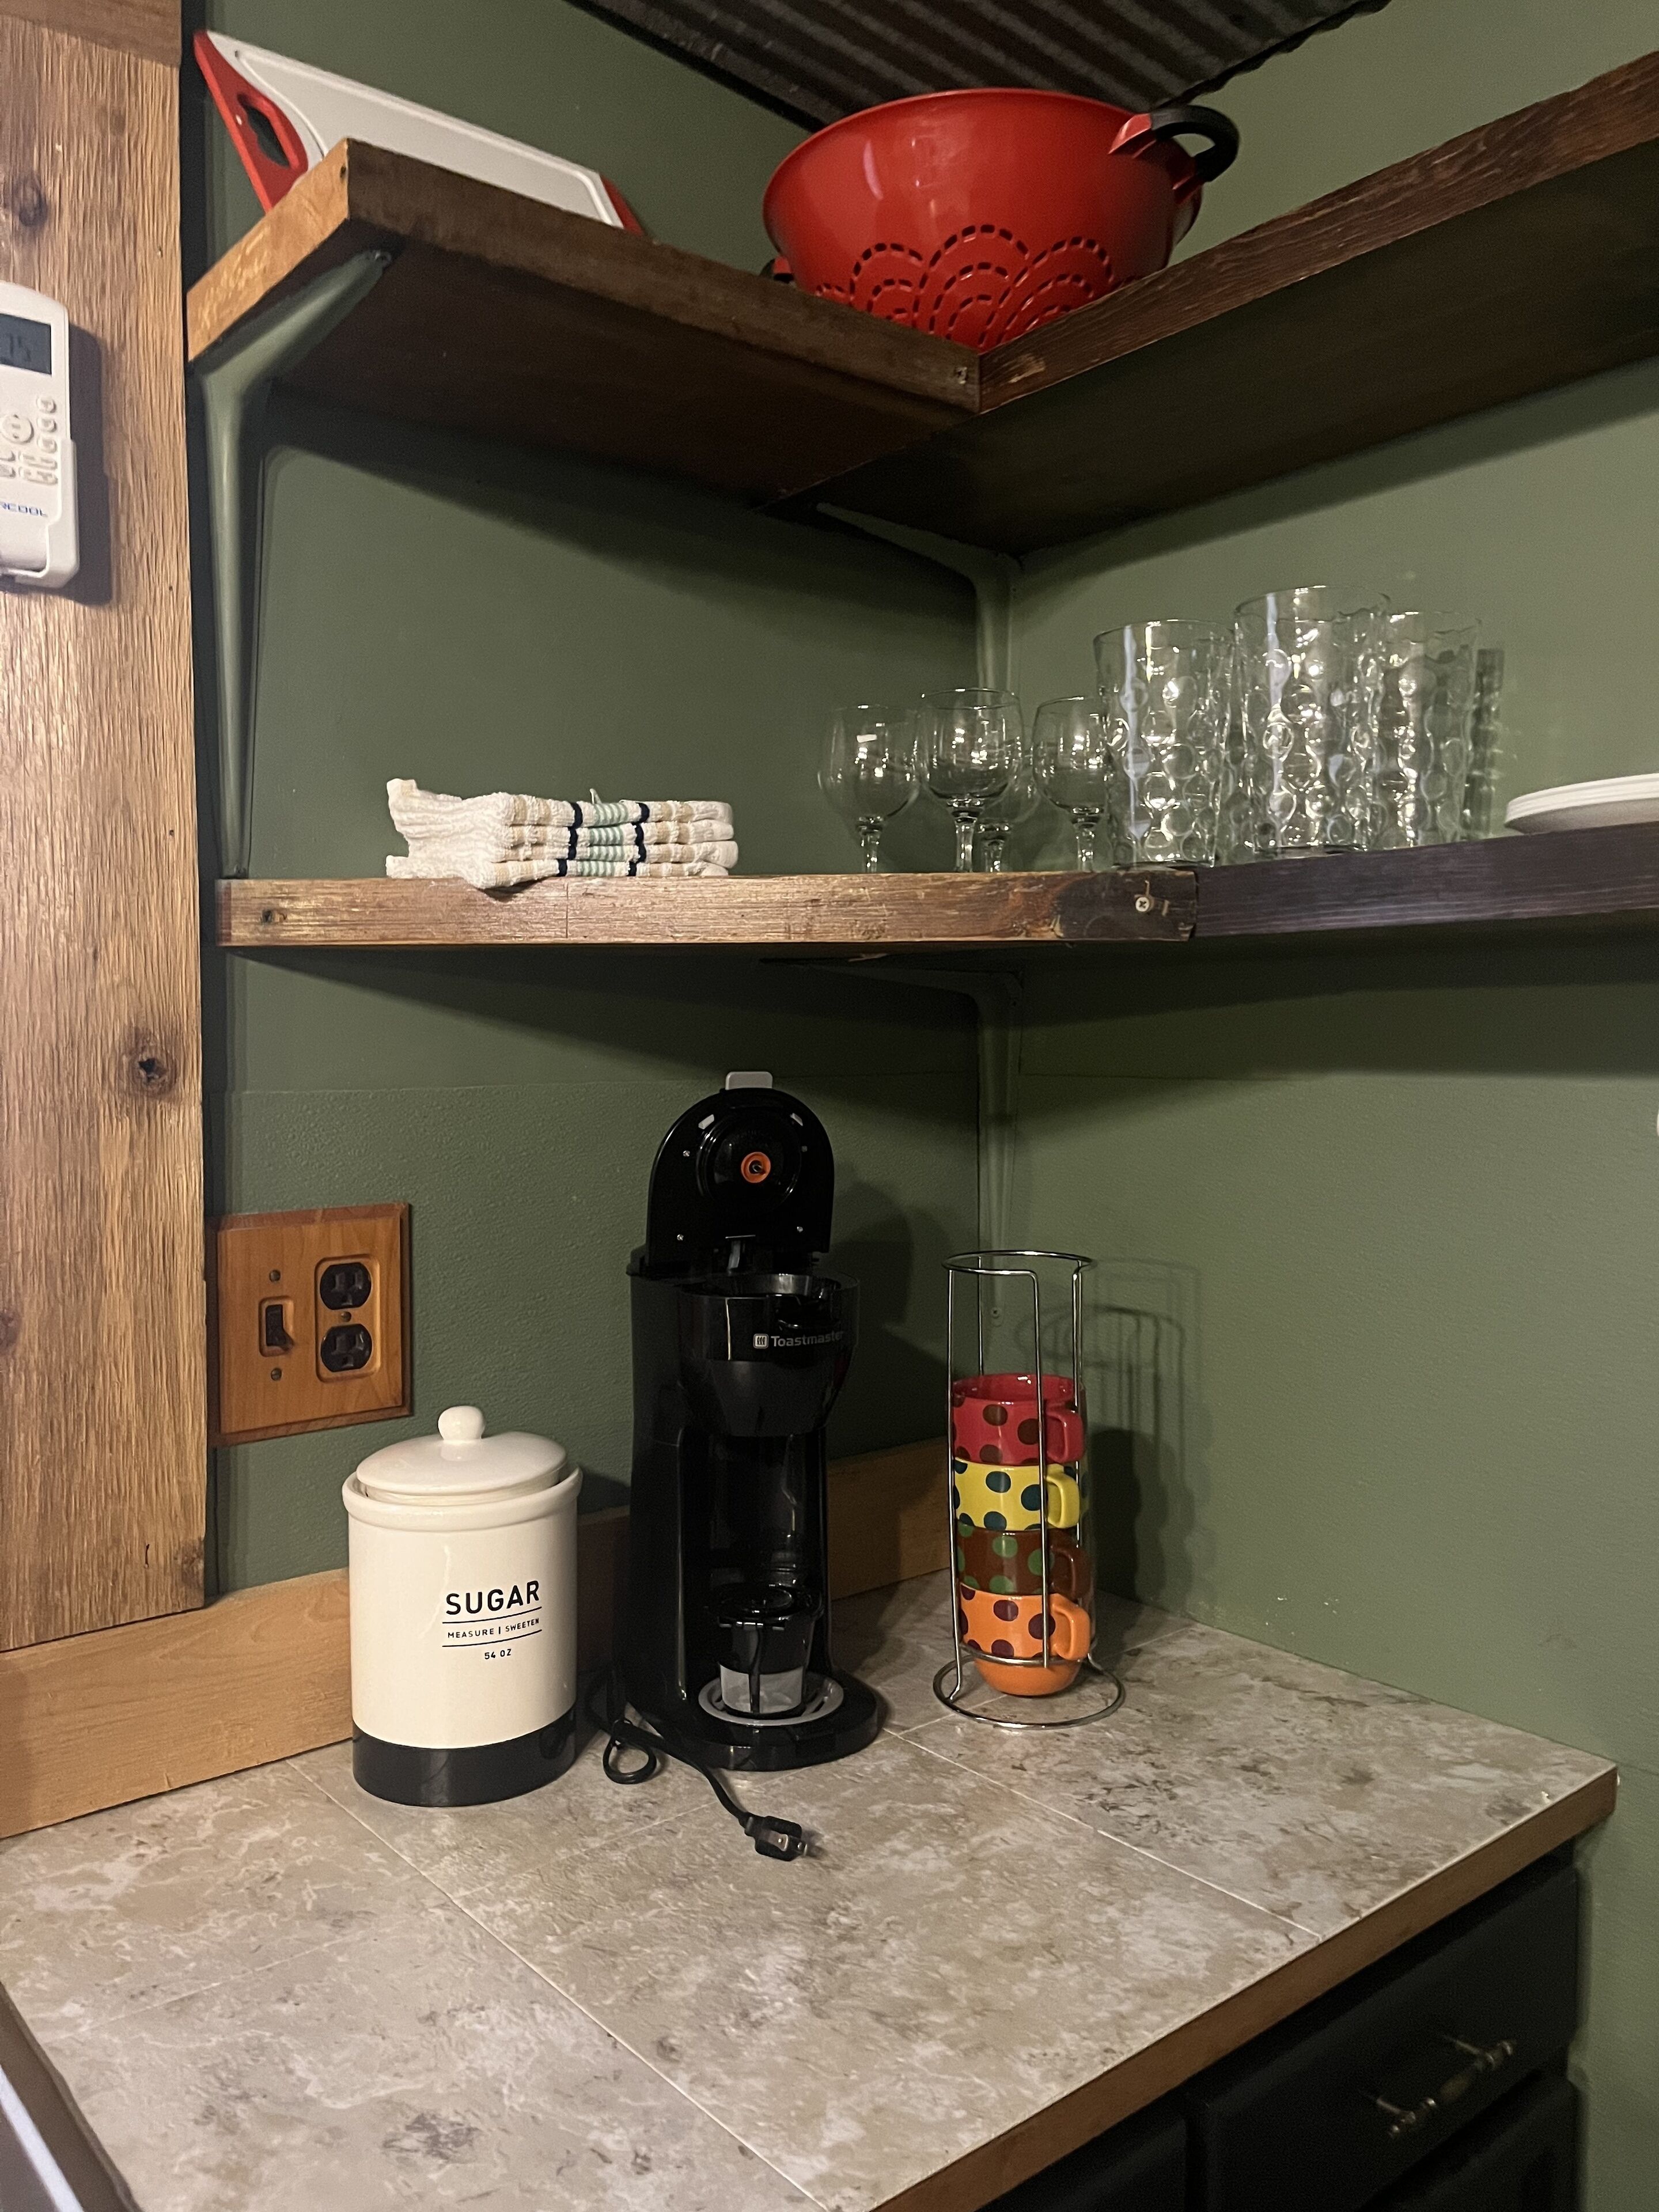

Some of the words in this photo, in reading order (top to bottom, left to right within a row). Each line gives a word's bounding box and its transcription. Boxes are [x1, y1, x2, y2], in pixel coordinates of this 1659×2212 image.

[770, 1331, 844, 1347] Toastmaster
[446, 1580, 539, 1615] SUGAR
[448, 1628, 494, 1638] MEASURE
[505, 1618, 539, 1632] SWEETEN
[484, 1652, 496, 1660] 54
[500, 1649, 512, 1657] OZ
